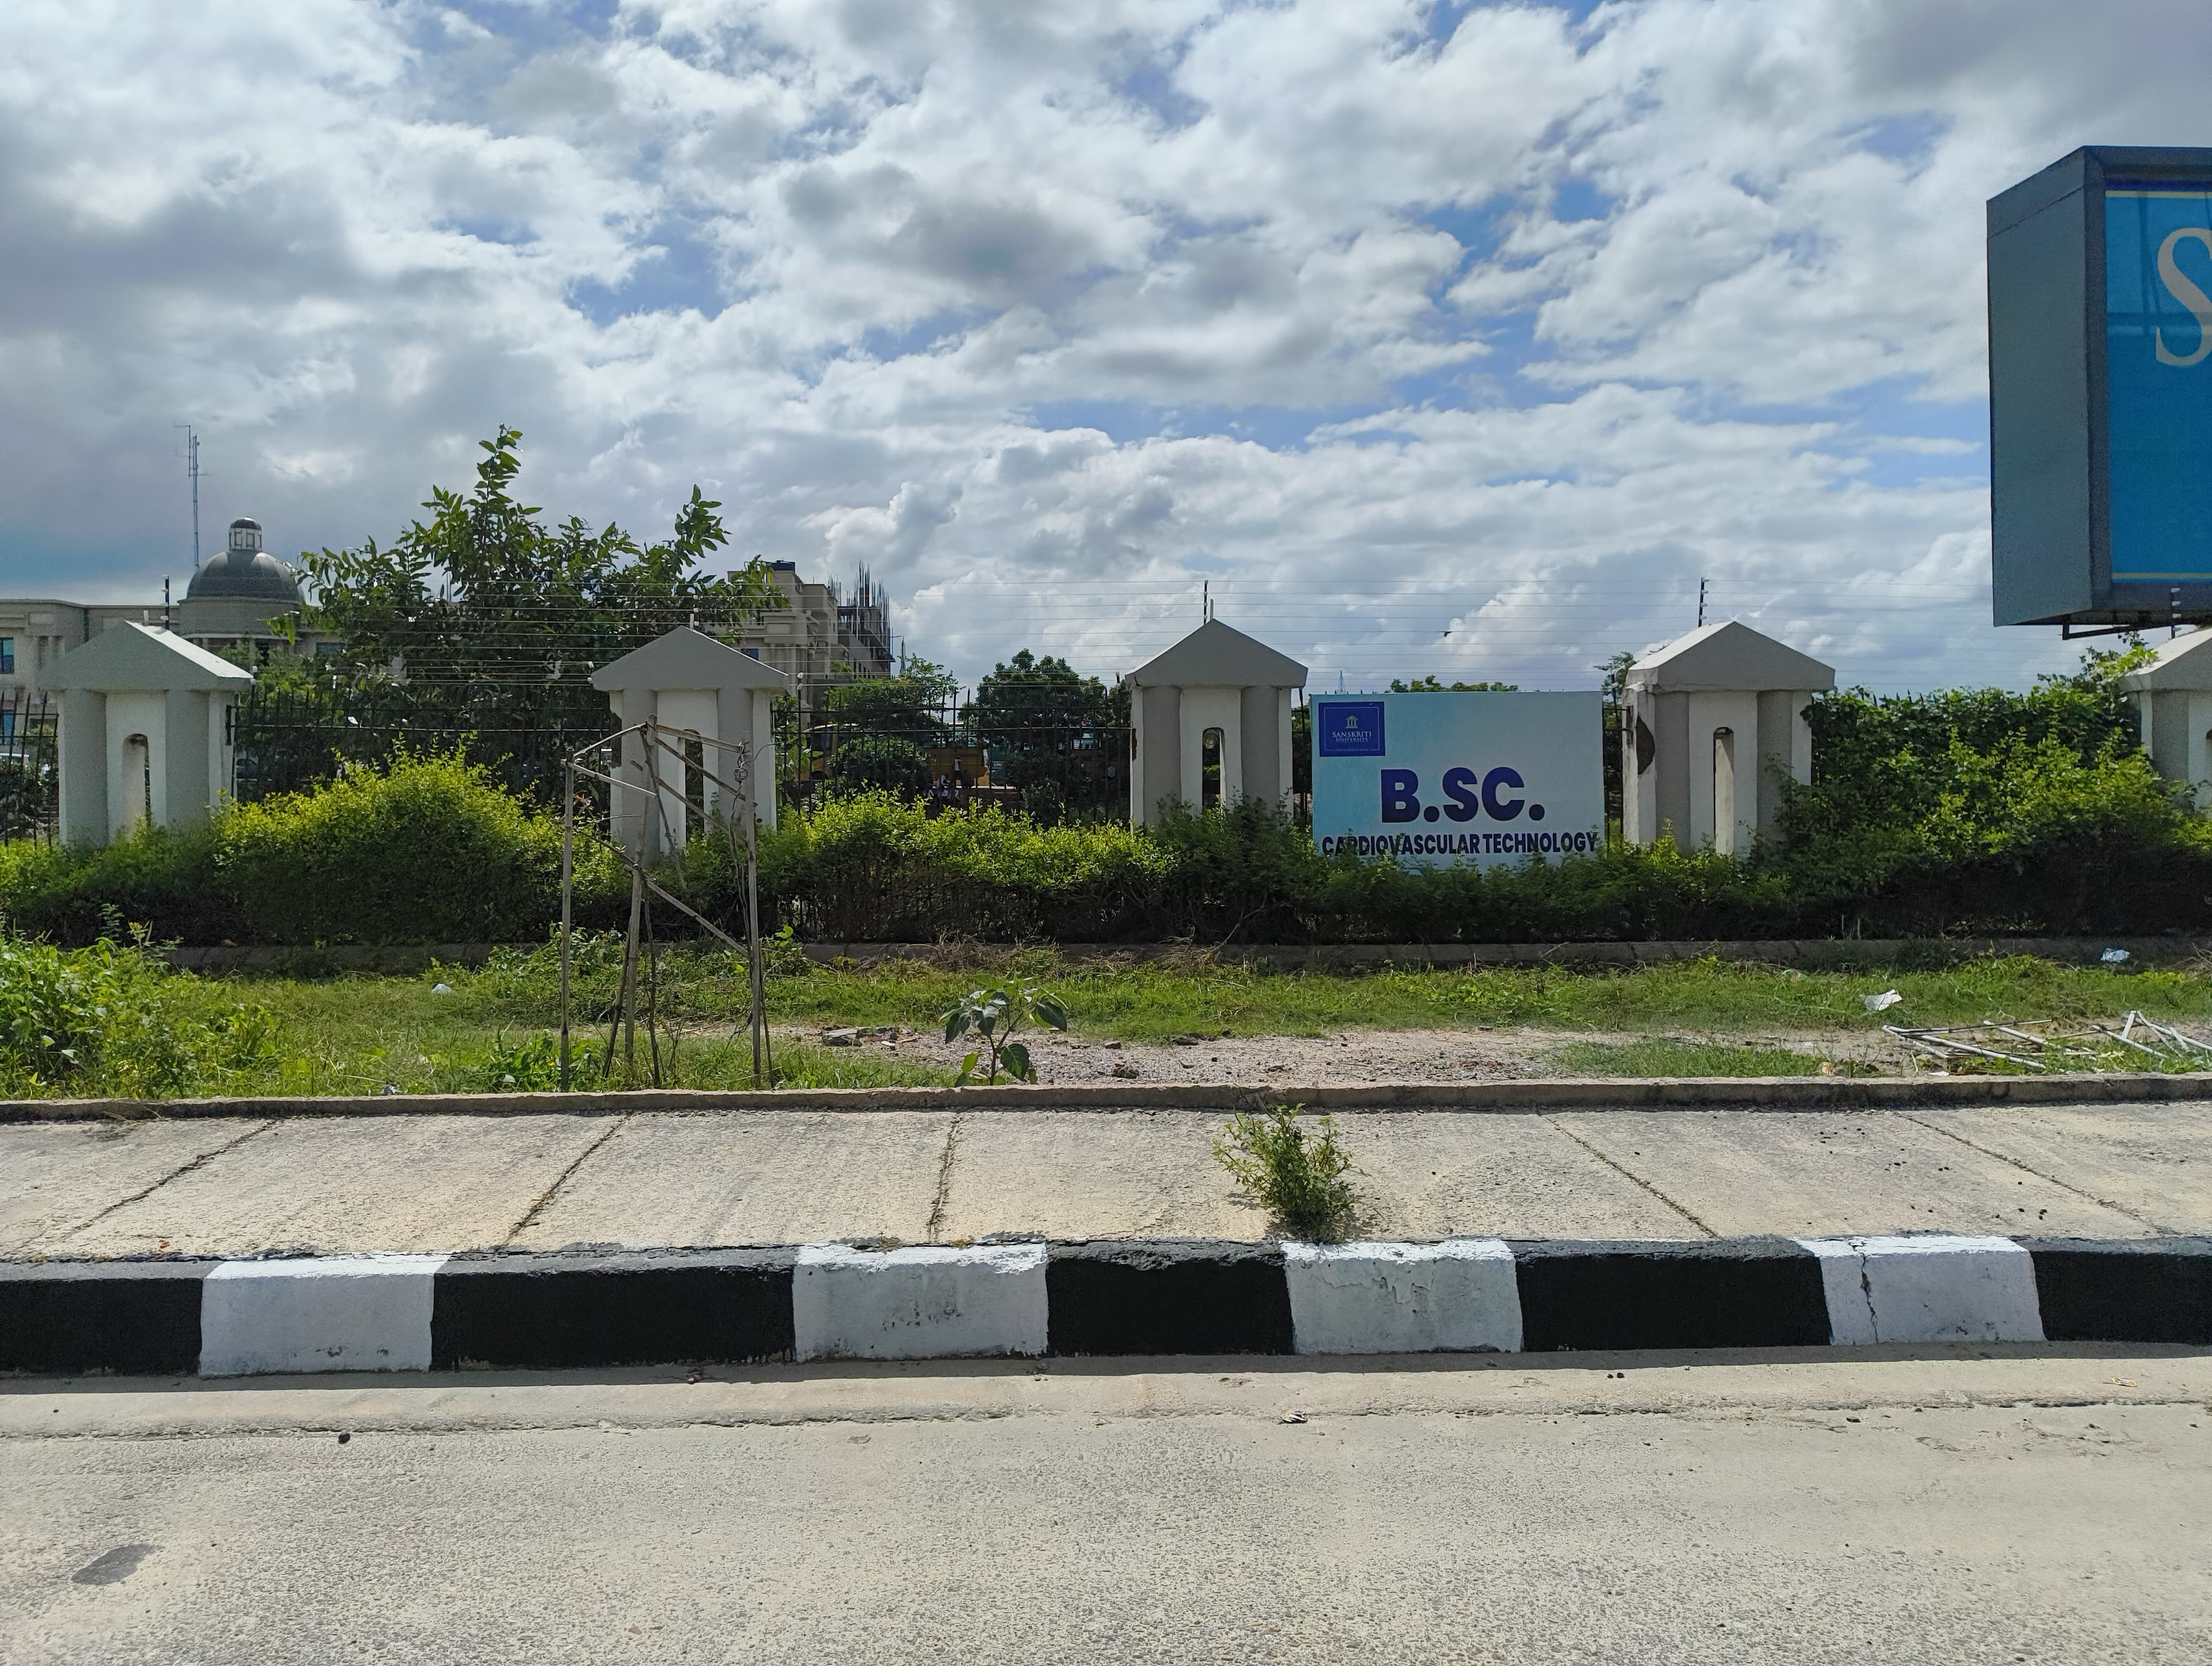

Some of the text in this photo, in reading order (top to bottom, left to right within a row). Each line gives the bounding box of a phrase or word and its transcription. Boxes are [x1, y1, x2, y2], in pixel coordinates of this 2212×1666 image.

[2156, 227, 2212, 366] S
[1381, 767, 1545, 823] B.SC.
[1483, 832, 1598, 854] TECHNOLOGY
